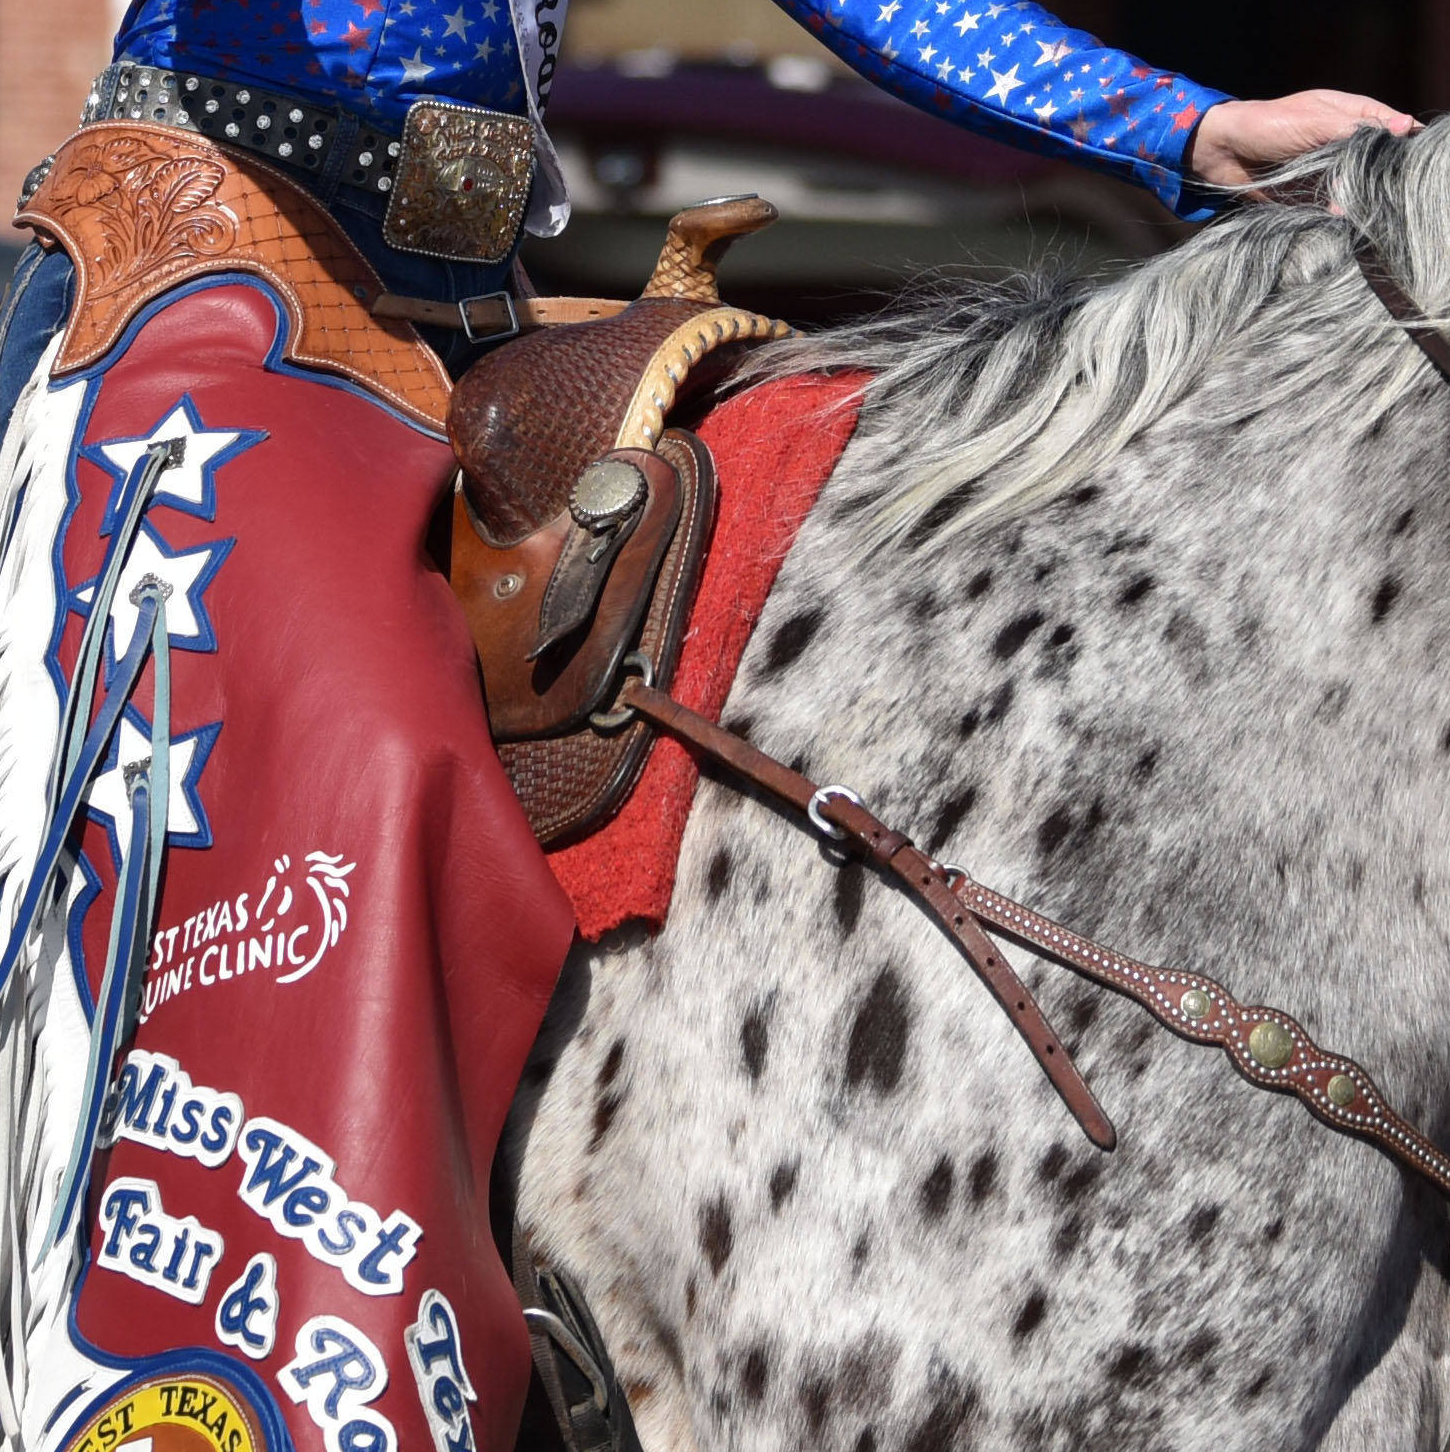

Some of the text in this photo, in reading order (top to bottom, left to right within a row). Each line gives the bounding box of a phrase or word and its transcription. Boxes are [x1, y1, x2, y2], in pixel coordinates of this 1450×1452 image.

[182, 892, 249, 954] TEXAS
[198, 924, 309, 986] CLINIC
[102, 1062, 233, 1154] Miss
[245, 1127, 411, 1285] West
[105, 1188, 214, 1289] Fair
[220, 1262, 269, 1347] &
[159, 1386, 243, 1452] TEXAS
